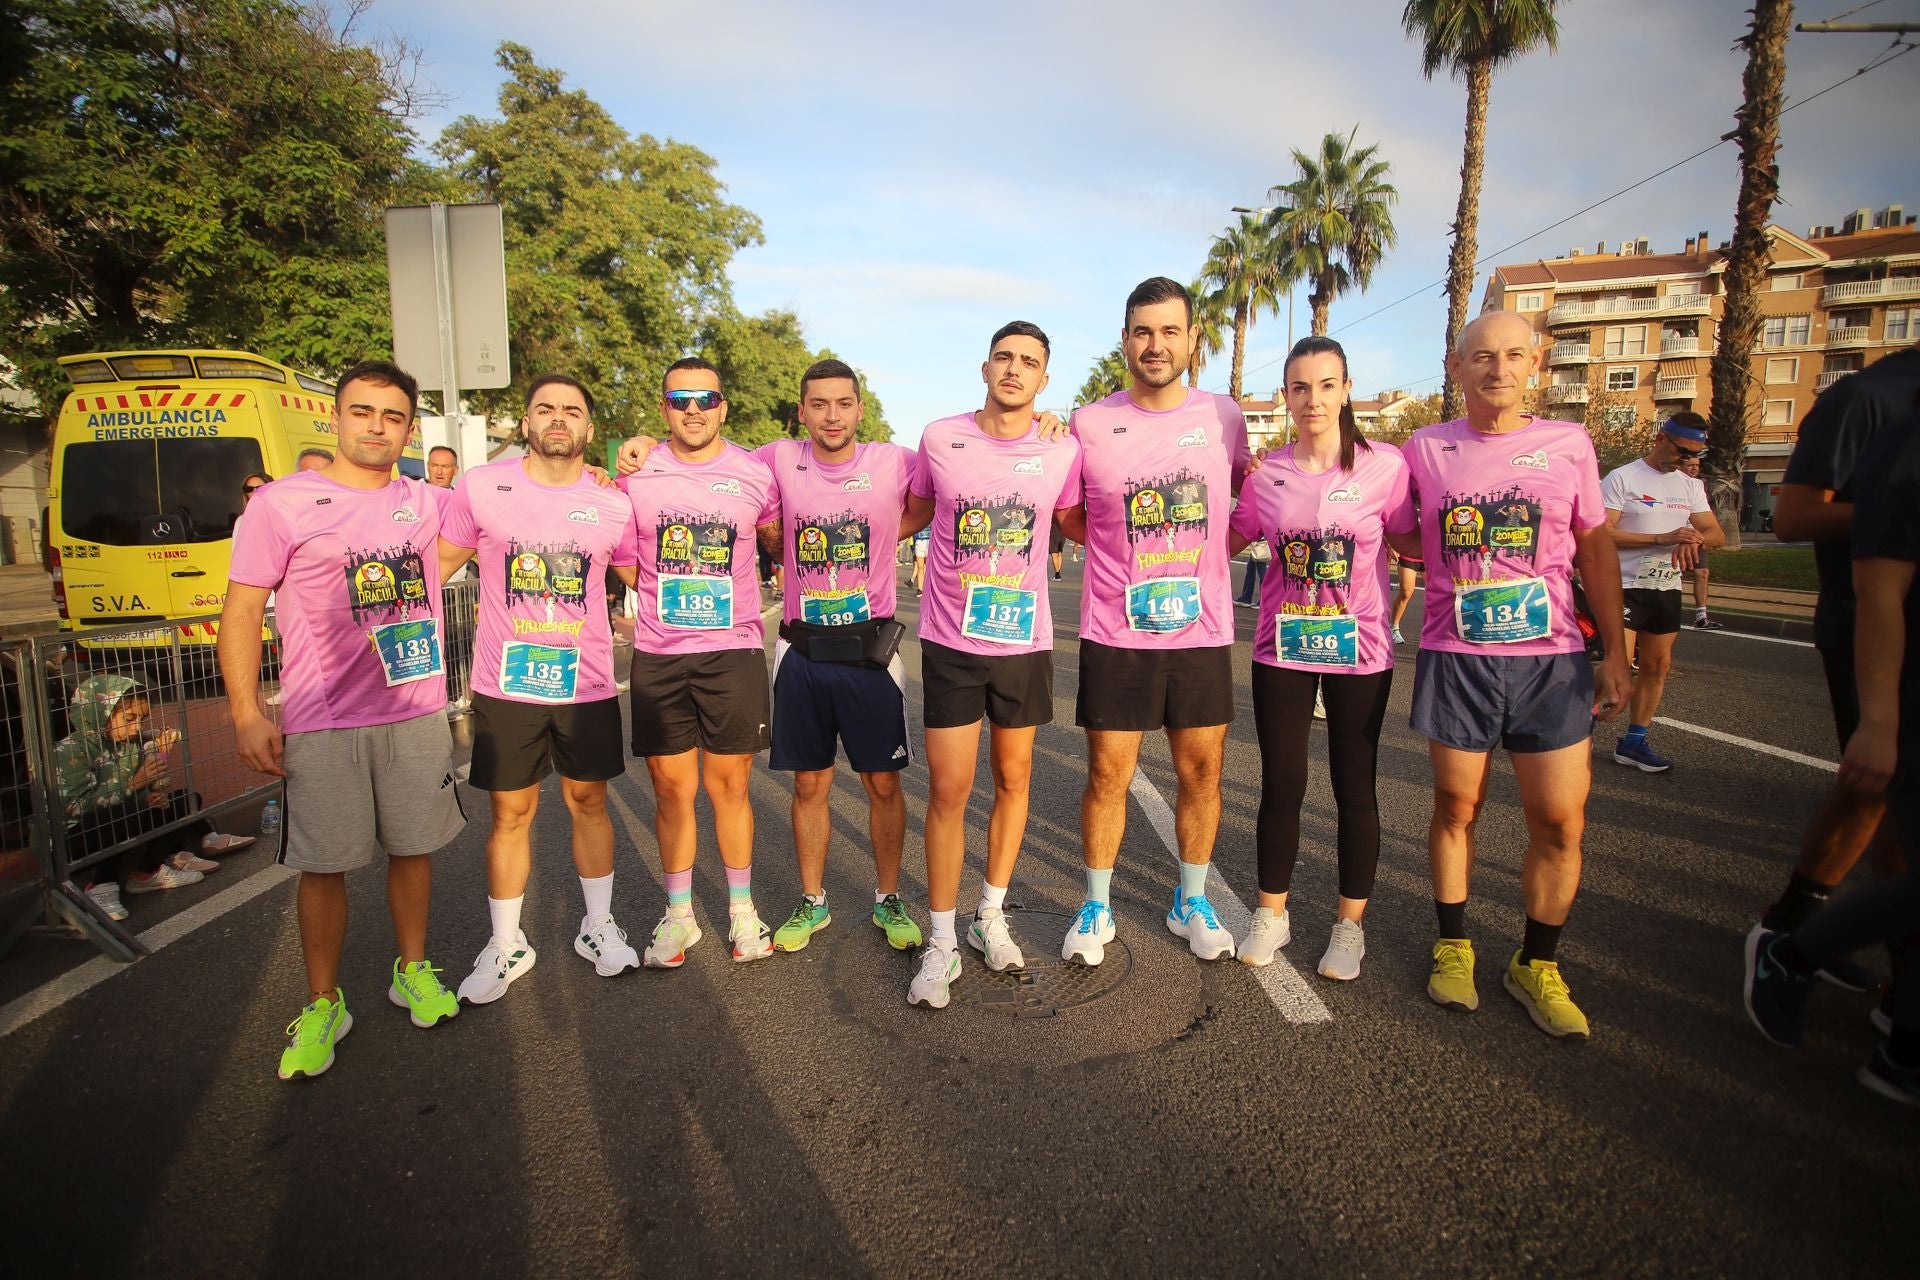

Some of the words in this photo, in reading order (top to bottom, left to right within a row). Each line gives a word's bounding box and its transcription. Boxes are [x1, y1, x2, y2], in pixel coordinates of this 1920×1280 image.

[87, 409, 227, 428] AMBULANCIA
[95, 425, 219, 441] EMERGENCIAS
[313, 420, 331, 433] SO
[1131, 512, 1165, 527] DRACULA
[1175, 507, 1200, 518] ZOMBIE
[958, 533, 990, 546] DRACULA
[1001, 531, 1027, 542] ZOMBIE
[1446, 531, 1482, 546] DRACULA
[1495, 530, 1527, 542] ZOMBIE
[147, 551, 163, 560] 112
[661, 548, 691, 560] DRACULA
[702, 549, 726, 559] ZOMBIE
[799, 550, 828, 562] DRACULA
[837, 548, 862, 558] ZOMBIE
[1136, 546, 1204, 573] HALLOWEEN
[1319, 563, 1343, 575] ZOMBIE
[511, 577, 545, 591] DRACULA
[555, 579, 581, 589] ZOMBIE
[958, 569, 1027, 591] HALLOWEEN
[358, 586, 398, 604] DRACULA
[677, 595, 714, 610] 138
[92, 594, 151, 613] S.V.A.
[1147, 597, 1184, 614] 140
[1280, 601, 1347, 616] HALLOWEEN
[819, 612, 854, 626] 139
[988, 603, 1021, 622] 137
[1482, 604, 1527, 623] 134
[512, 617, 586, 638] HALLOWEEN
[394, 638, 430, 659] 133
[1299, 634, 1338, 650] 136
[525, 661, 563, 681] 135
